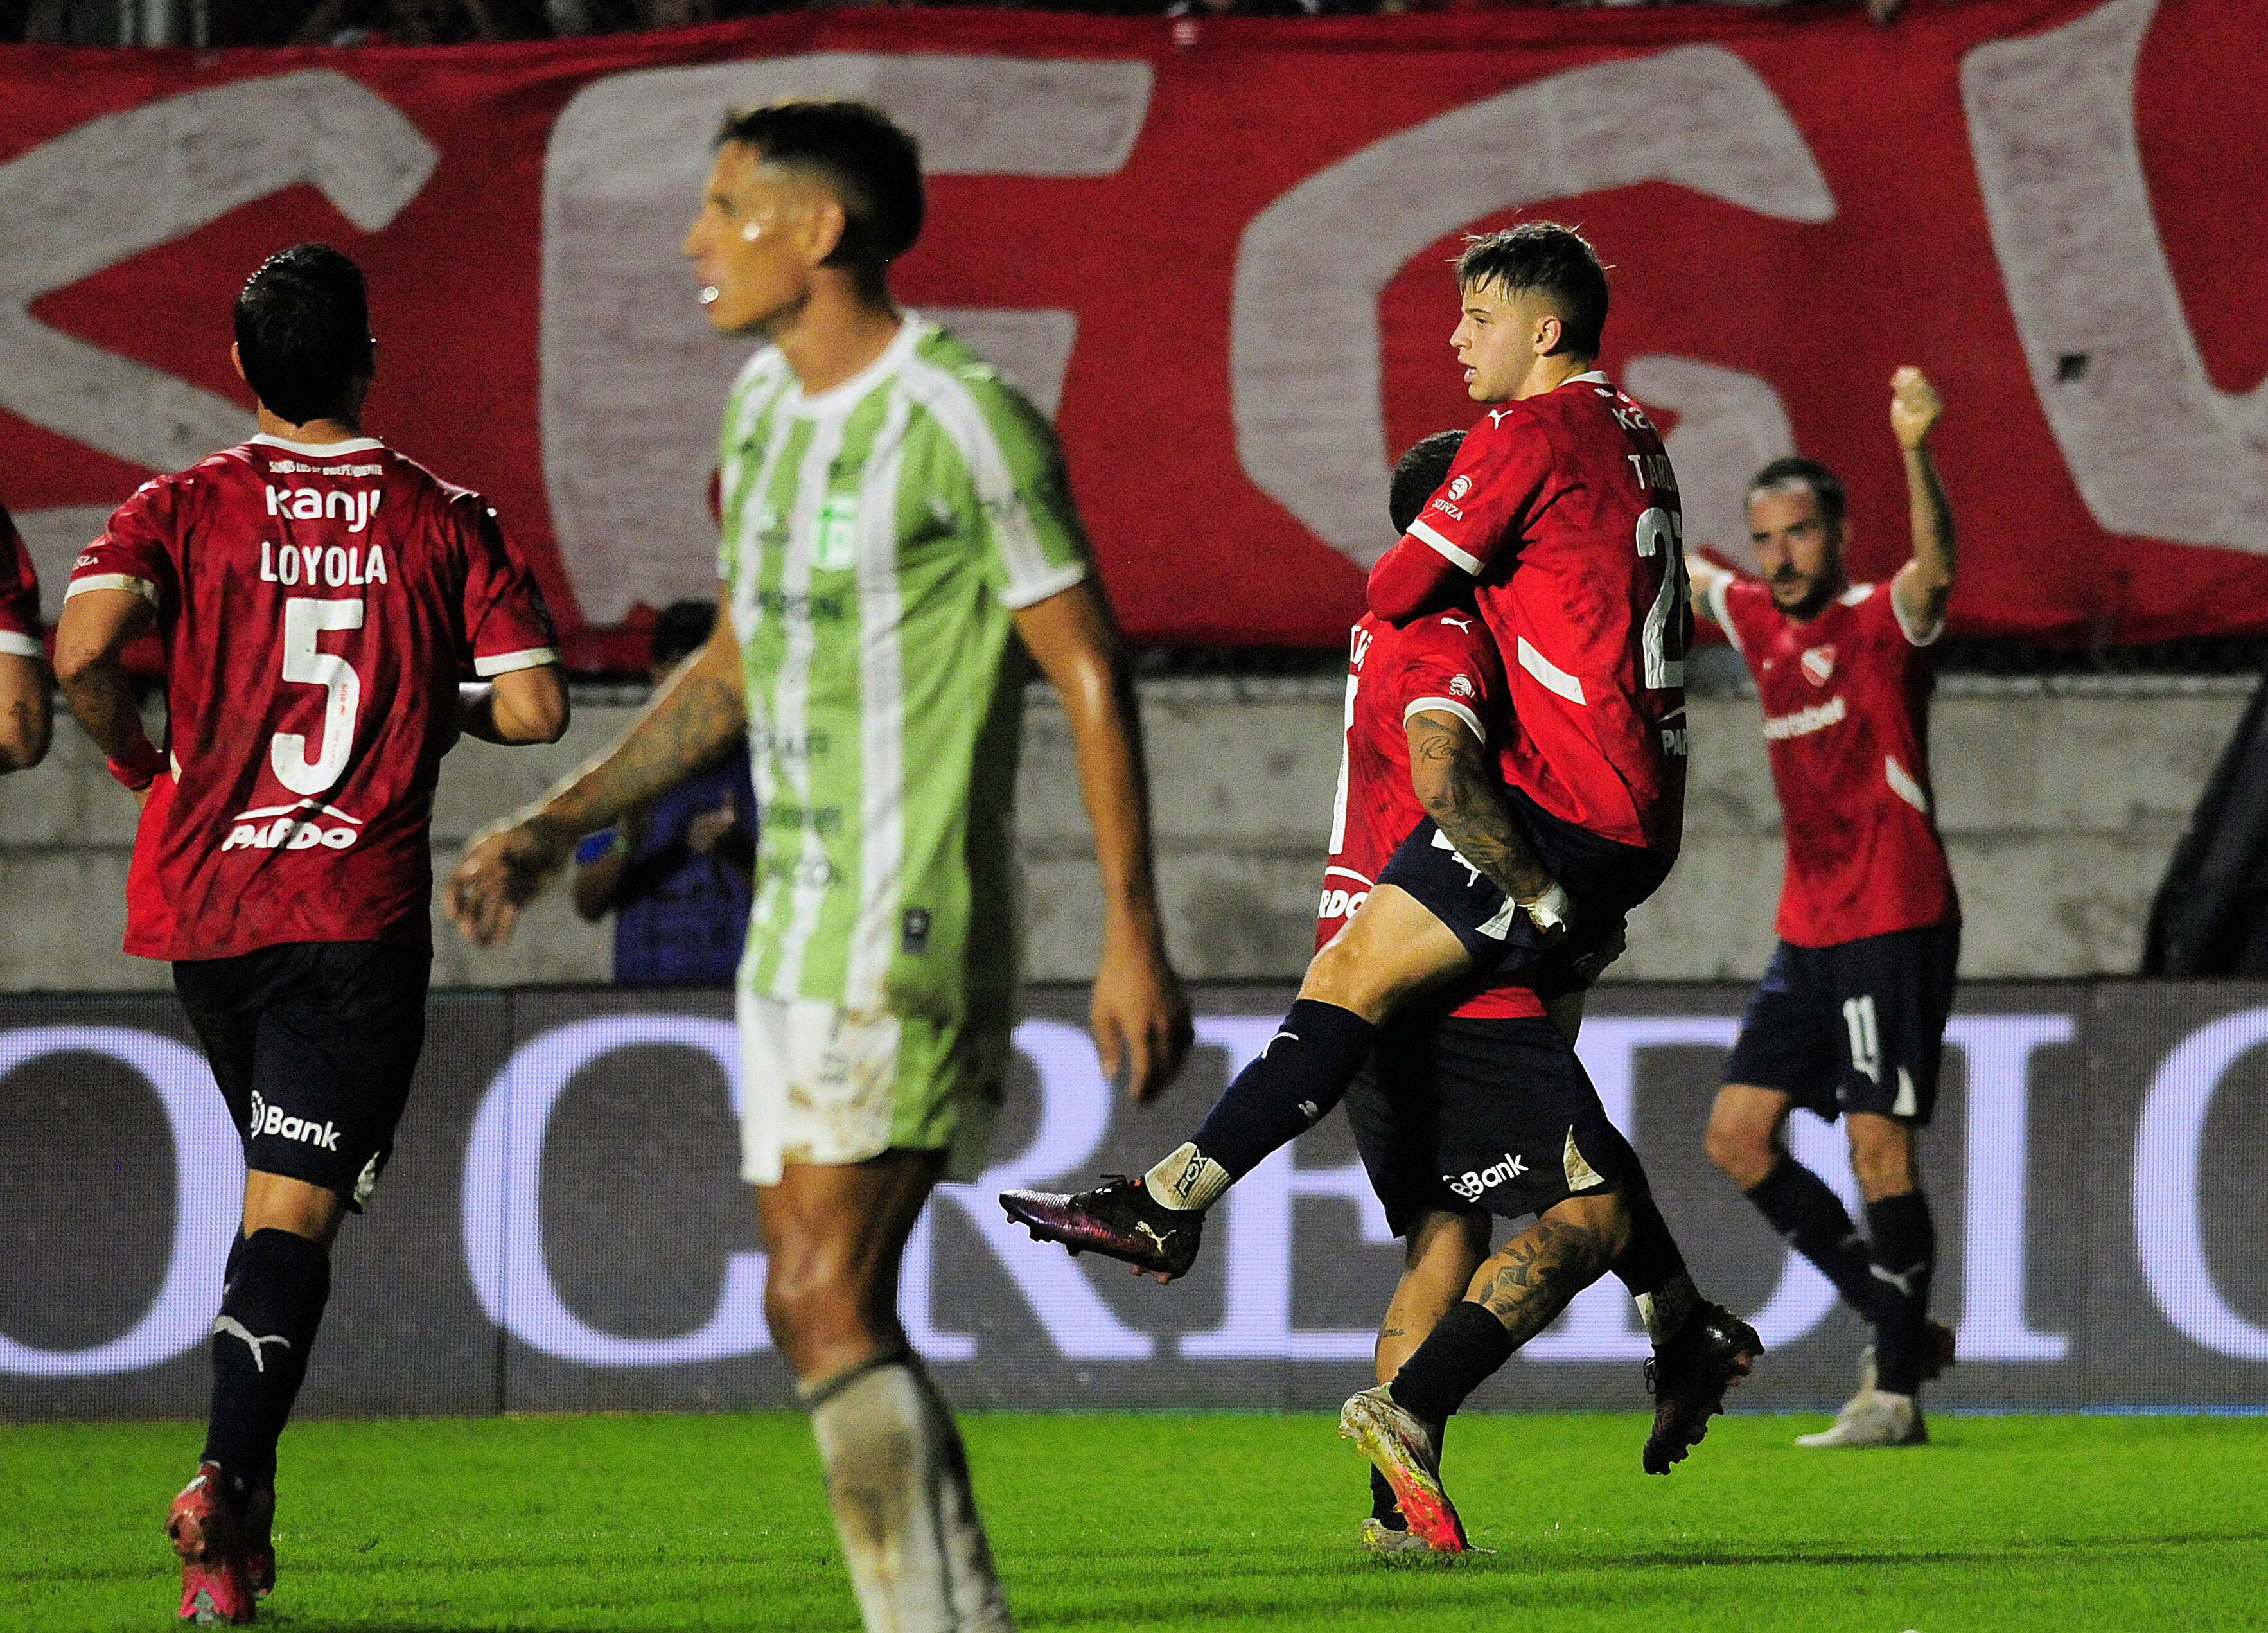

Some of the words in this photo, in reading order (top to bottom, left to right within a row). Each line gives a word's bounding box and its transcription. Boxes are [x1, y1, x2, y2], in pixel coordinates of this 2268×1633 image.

[260, 541, 387, 587] LOYOLA
[270, 598, 364, 795] 5
[221, 817, 358, 852] PARDO
[1842, 995, 1881, 1084] 11
[263, 1104, 342, 1152] Bank
[1461, 1152, 1529, 1195] Bank
